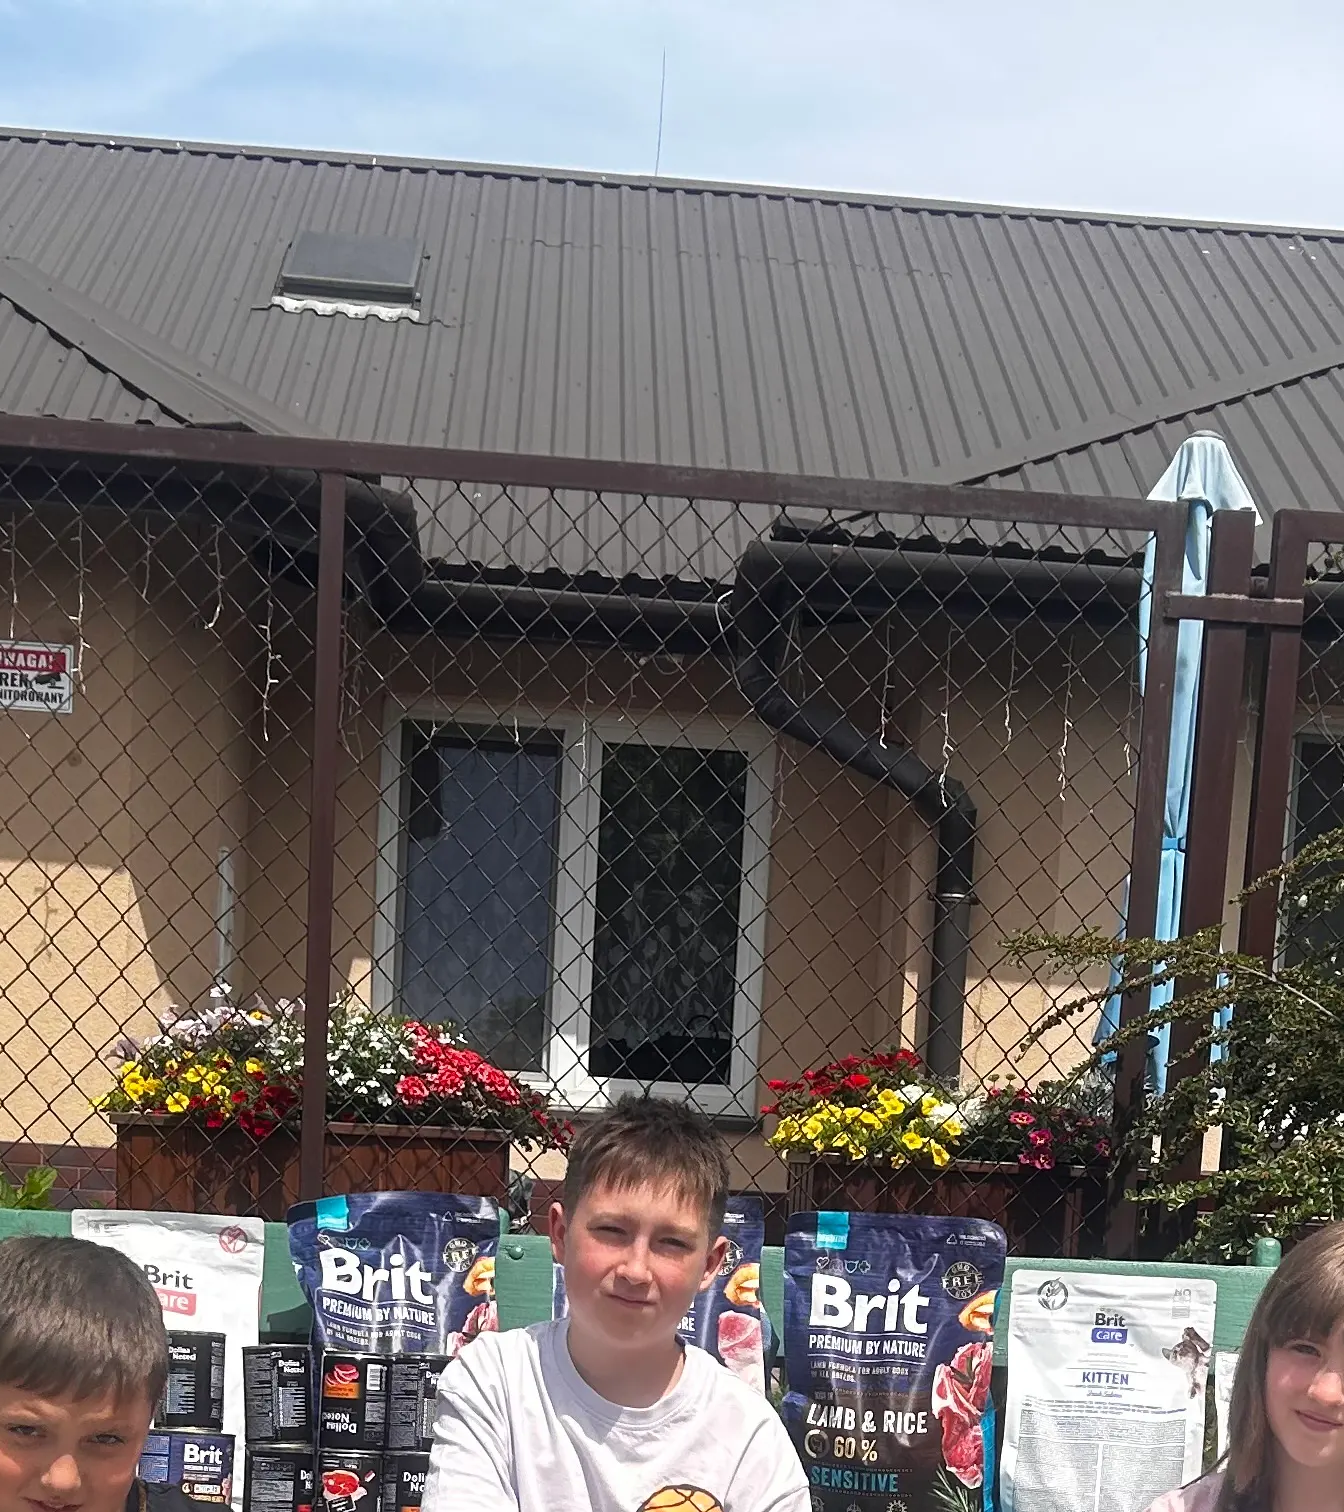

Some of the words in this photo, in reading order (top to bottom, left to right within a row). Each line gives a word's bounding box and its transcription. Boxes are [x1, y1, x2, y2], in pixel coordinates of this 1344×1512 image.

[144, 1264, 193, 1289] Brit
[319, 1247, 433, 1304] Brit
[941, 1272, 983, 1288] FREE
[161, 1293, 189, 1310] are
[323, 1297, 372, 1321] PREMIUM
[376, 1307, 391, 1322] BY
[392, 1306, 436, 1326] NATURE
[809, 1272, 930, 1334] Brit
[1094, 1312, 1126, 1328] Brit
[809, 1334, 863, 1355] PREMIUM
[866, 1340, 880, 1355] BY
[883, 1340, 926, 1358] NATURE
[1096, 1330, 1123, 1341] care
[1082, 1371, 1129, 1385] KITTEN
[806, 1403, 856, 1431] LAMB
[861, 1410, 877, 1433] &
[883, 1410, 928, 1434] RICE
[183, 1443, 223, 1464] Brit
[834, 1436, 856, 1459] 60
[861, 1439, 878, 1462] %
[810, 1466, 899, 1493] SENSITIVE
